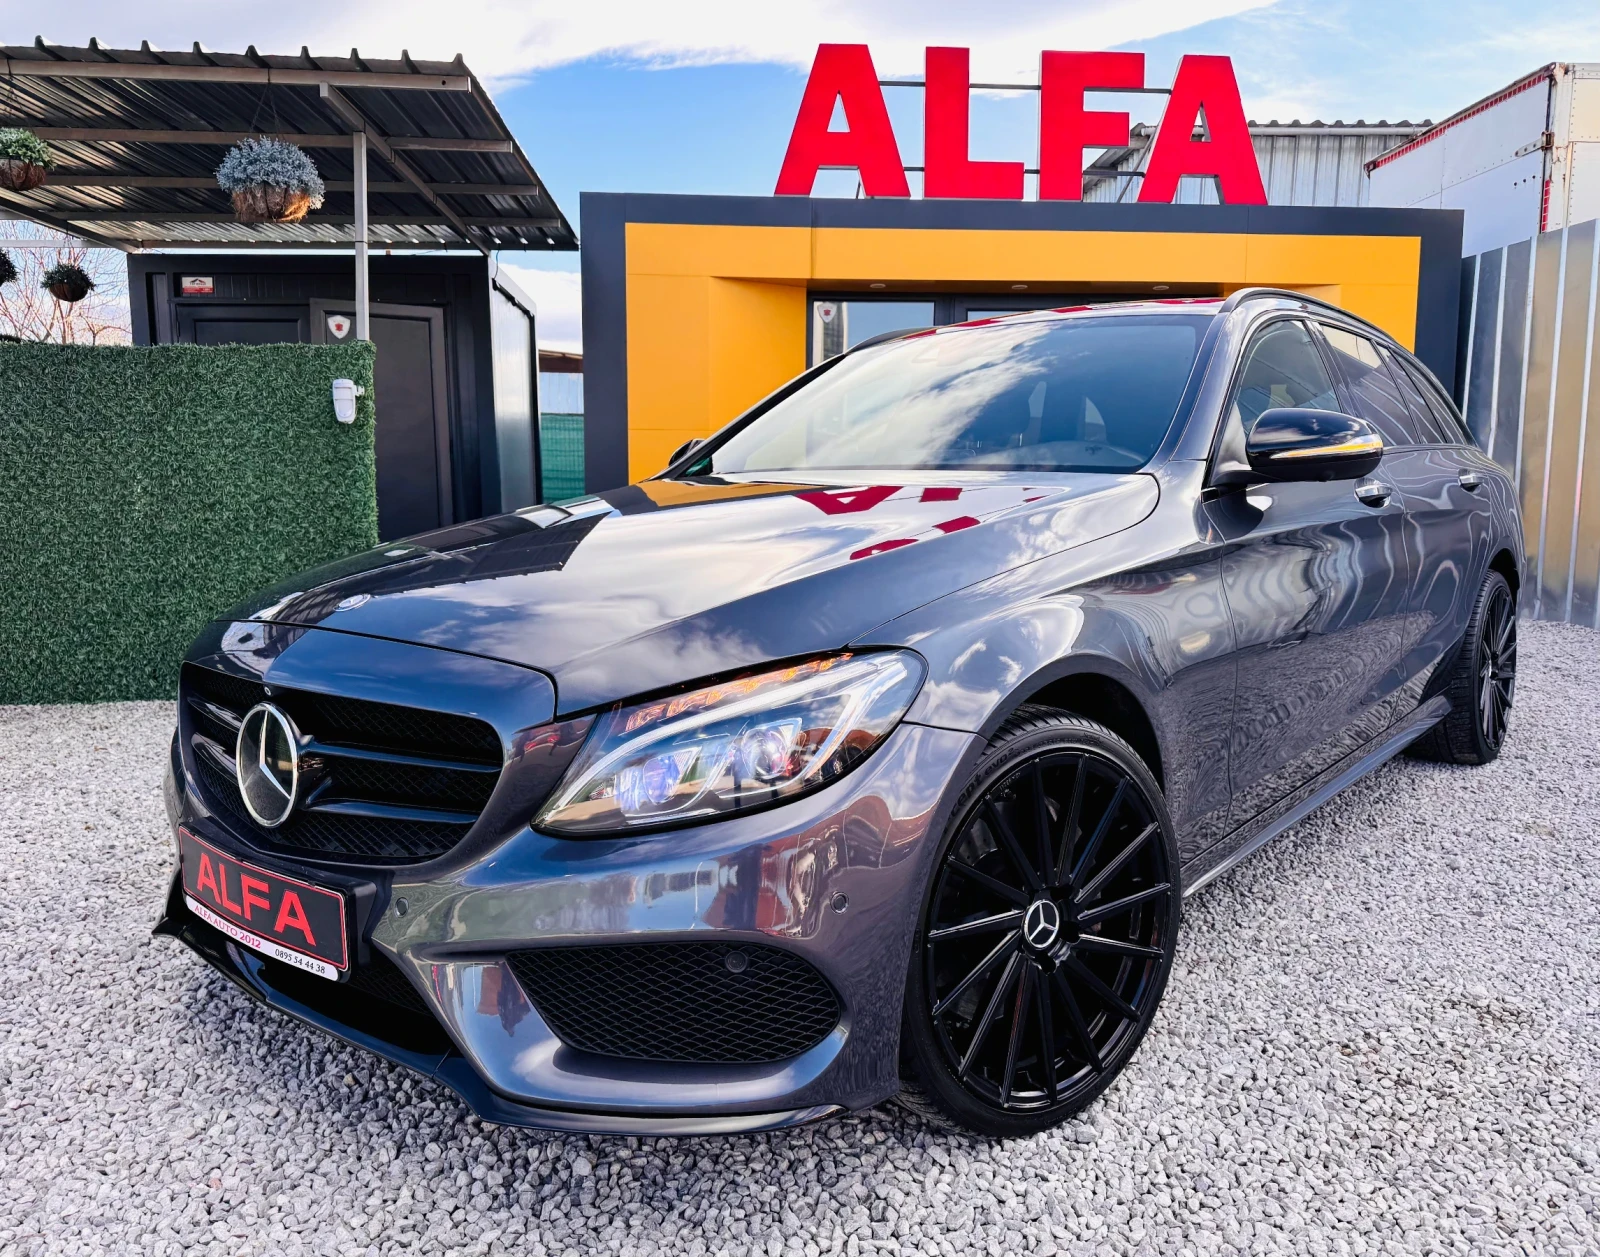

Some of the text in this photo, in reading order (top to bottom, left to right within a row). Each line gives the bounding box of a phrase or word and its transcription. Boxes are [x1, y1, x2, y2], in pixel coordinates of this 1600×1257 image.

[775, 43, 1267, 205] ALFA
[194, 905, 262, 950] ALFA AUTO 2012
[196, 852, 316, 947] ALFA
[274, 948, 326, 975] 0895 54 44 38
